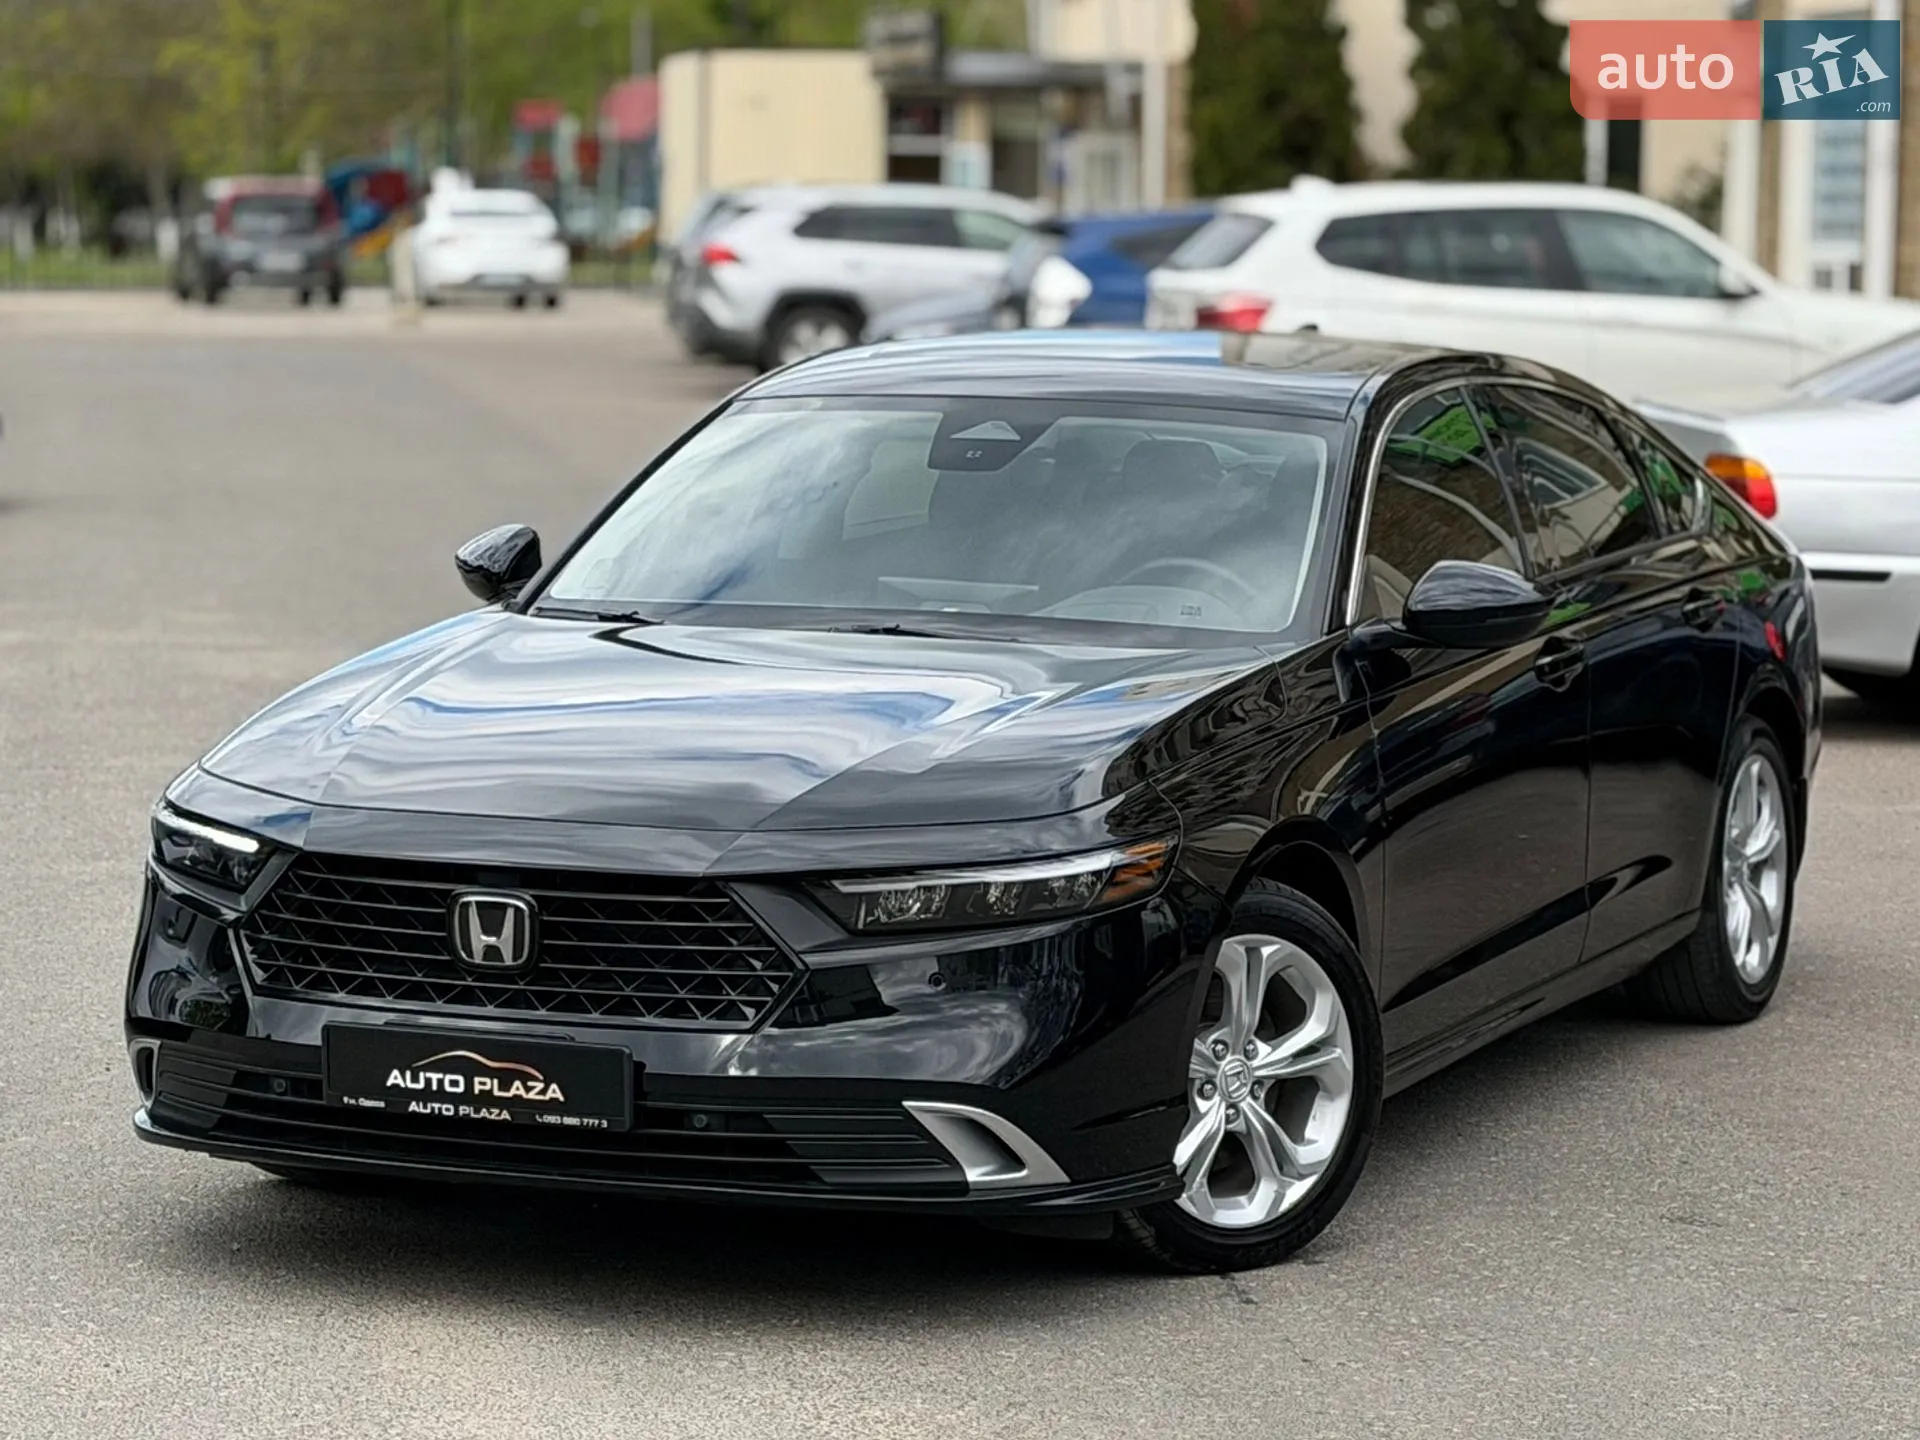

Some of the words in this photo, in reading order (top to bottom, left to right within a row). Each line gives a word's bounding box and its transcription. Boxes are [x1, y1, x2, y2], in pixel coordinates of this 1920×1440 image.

[386, 1069, 465, 1093] AUTO
[473, 1076, 565, 1102] PLAZA
[408, 1101, 454, 1116] AUTO
[458, 1106, 512, 1121] PLAZA
